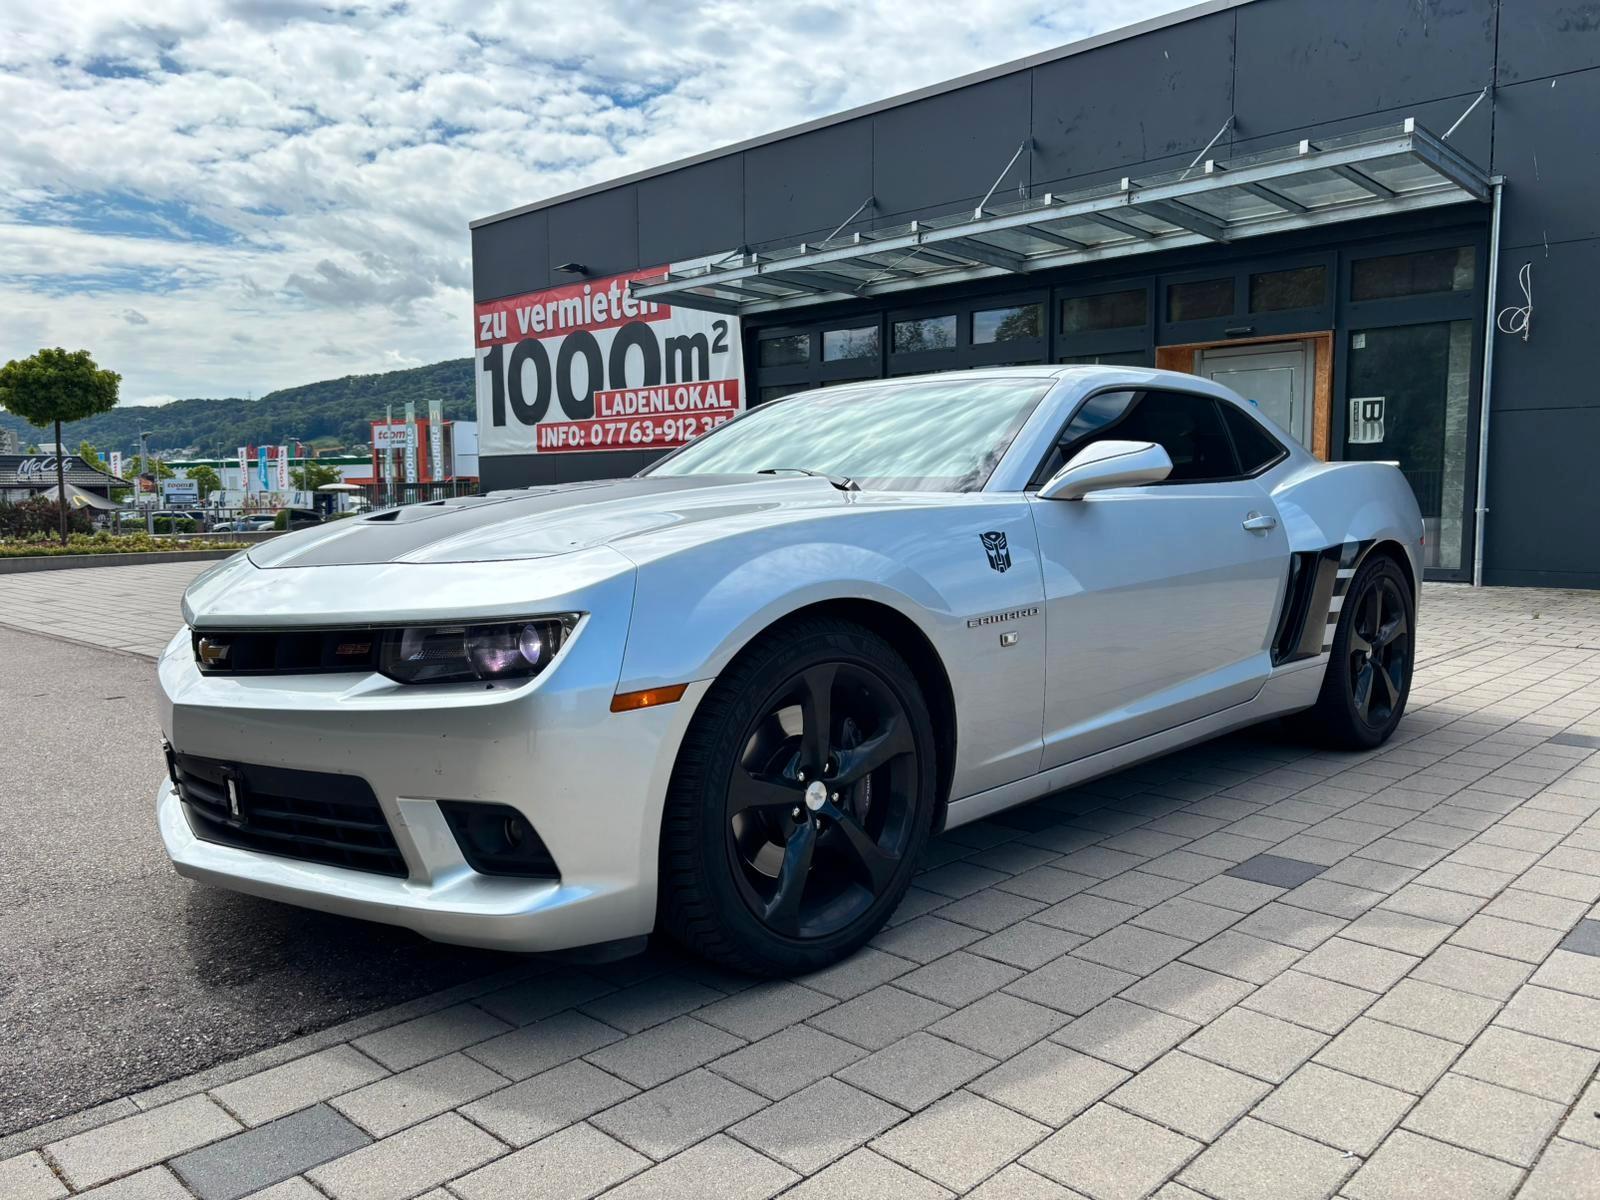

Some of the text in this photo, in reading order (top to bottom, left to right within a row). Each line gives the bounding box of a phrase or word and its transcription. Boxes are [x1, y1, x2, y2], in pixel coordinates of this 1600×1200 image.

[480, 311, 507, 341] zu
[601, 383, 732, 417] LADENLOKAL
[541, 424, 586, 448] INFO:
[967, 607, 1040, 629] CAMARO
